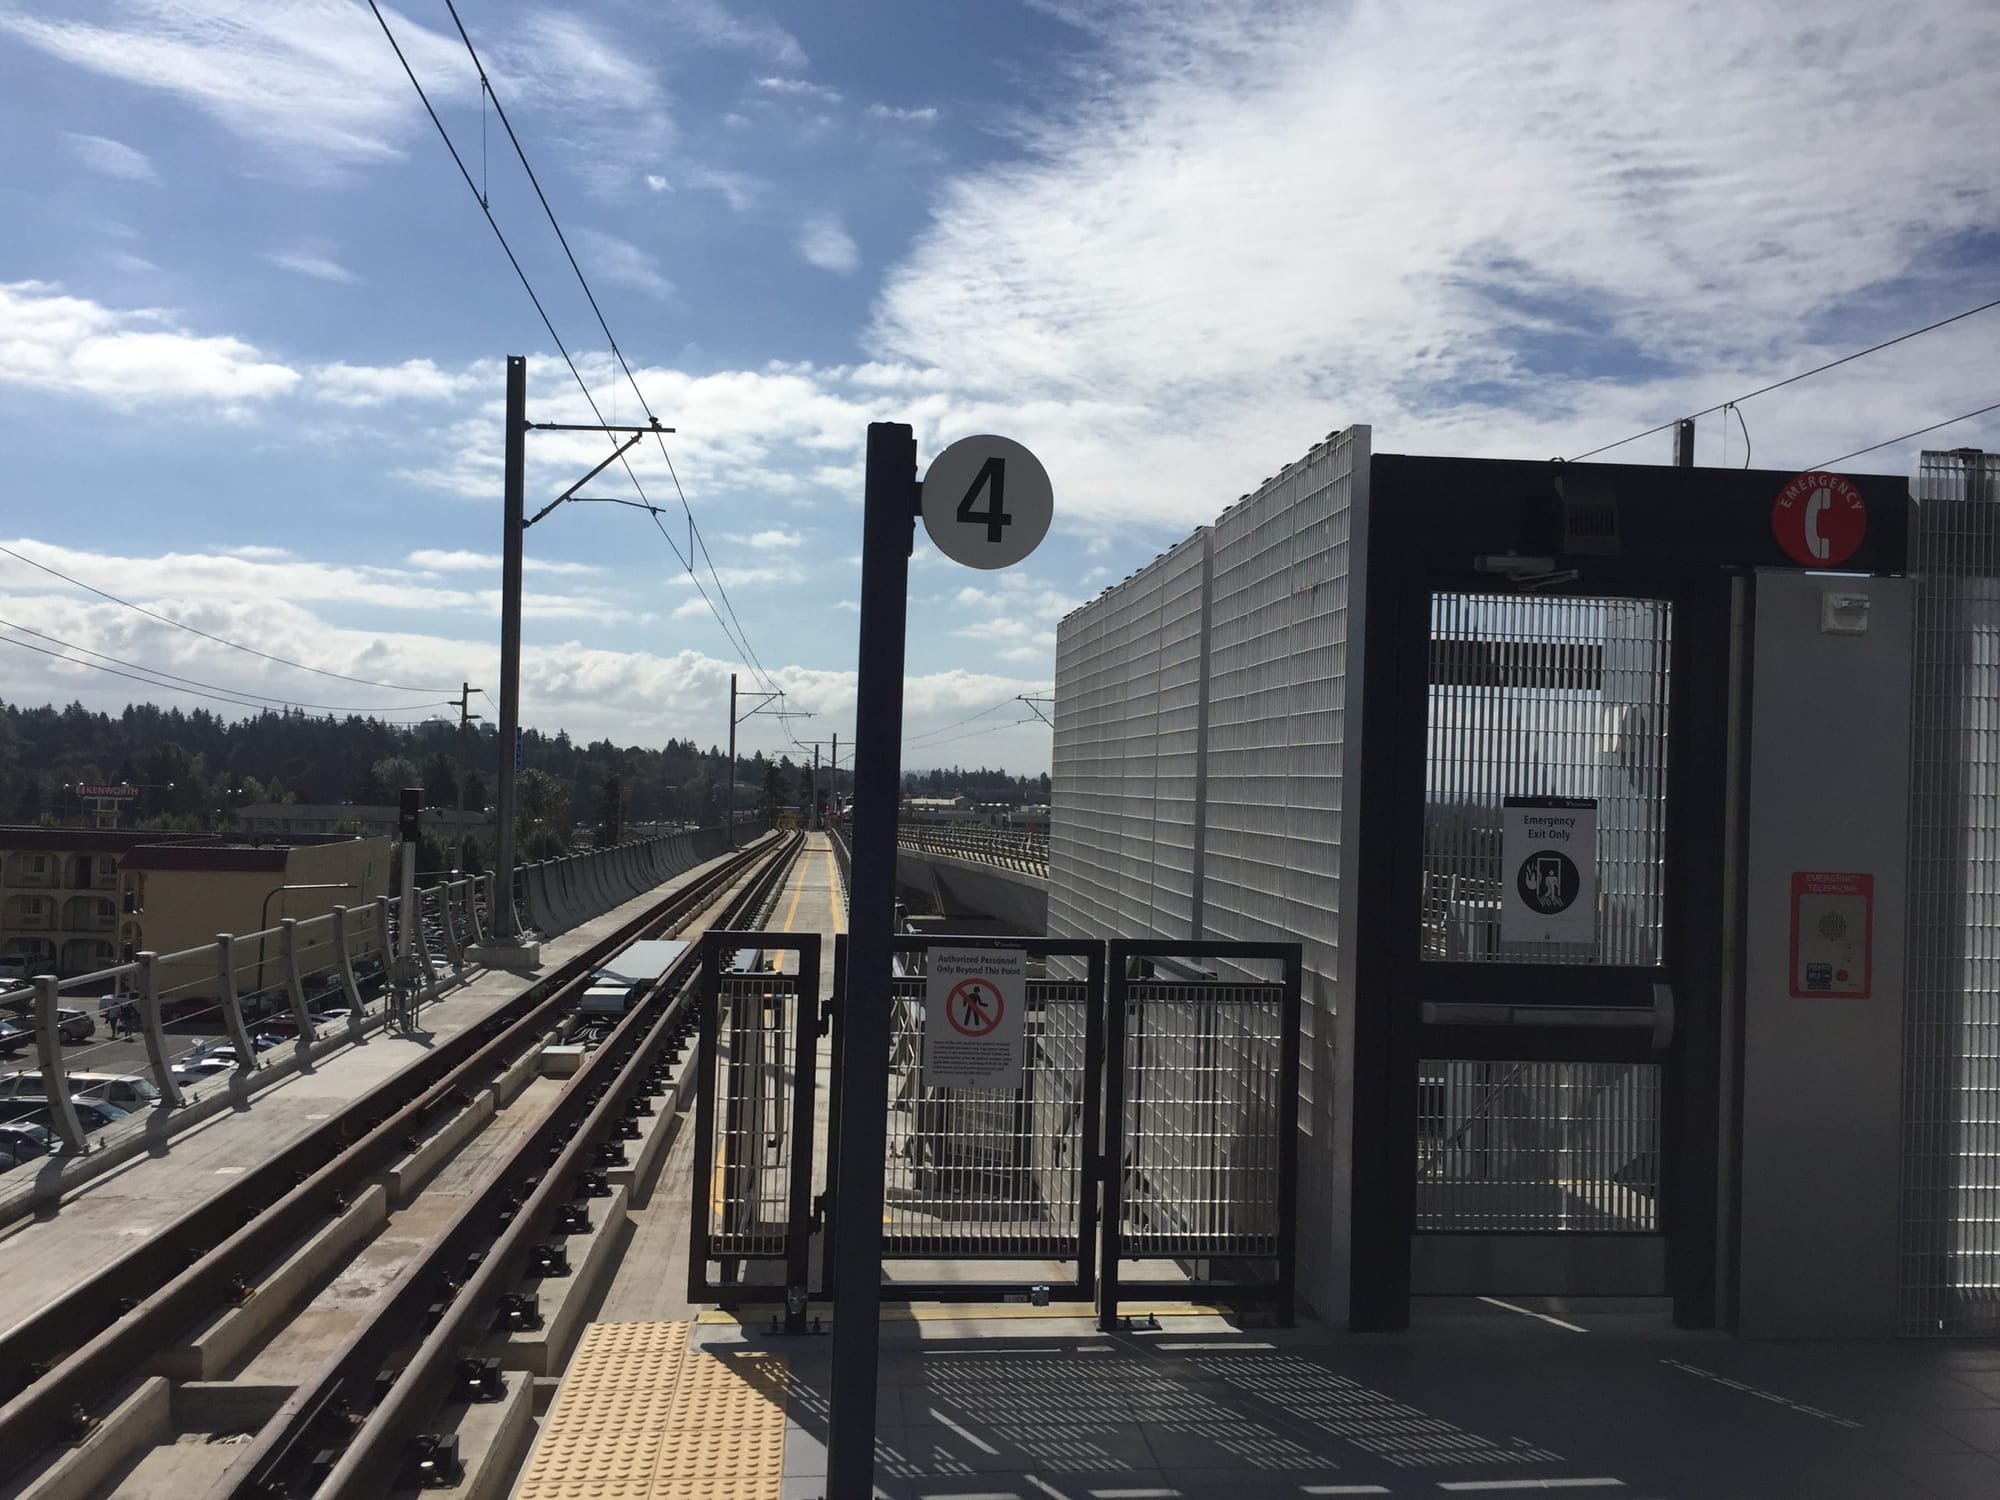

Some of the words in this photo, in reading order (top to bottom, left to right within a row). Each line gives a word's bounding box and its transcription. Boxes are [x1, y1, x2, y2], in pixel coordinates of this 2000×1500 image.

[1779, 474, 1863, 510] EMERGENCY
[956, 456, 1012, 543] 4
[86, 786, 138, 796] KENWORTH
[1524, 815, 1576, 827] Emergency
[1528, 829, 1546, 840] Exit
[1549, 829, 1571, 842] Only
[938, 954, 979, 964] Authorized
[981, 956, 1017, 966] Personnel
[937, 965, 955, 975] Only
[956, 966, 983, 976] Beyond
[985, 966, 999, 975] This
[1001, 967, 1021, 977] Point
